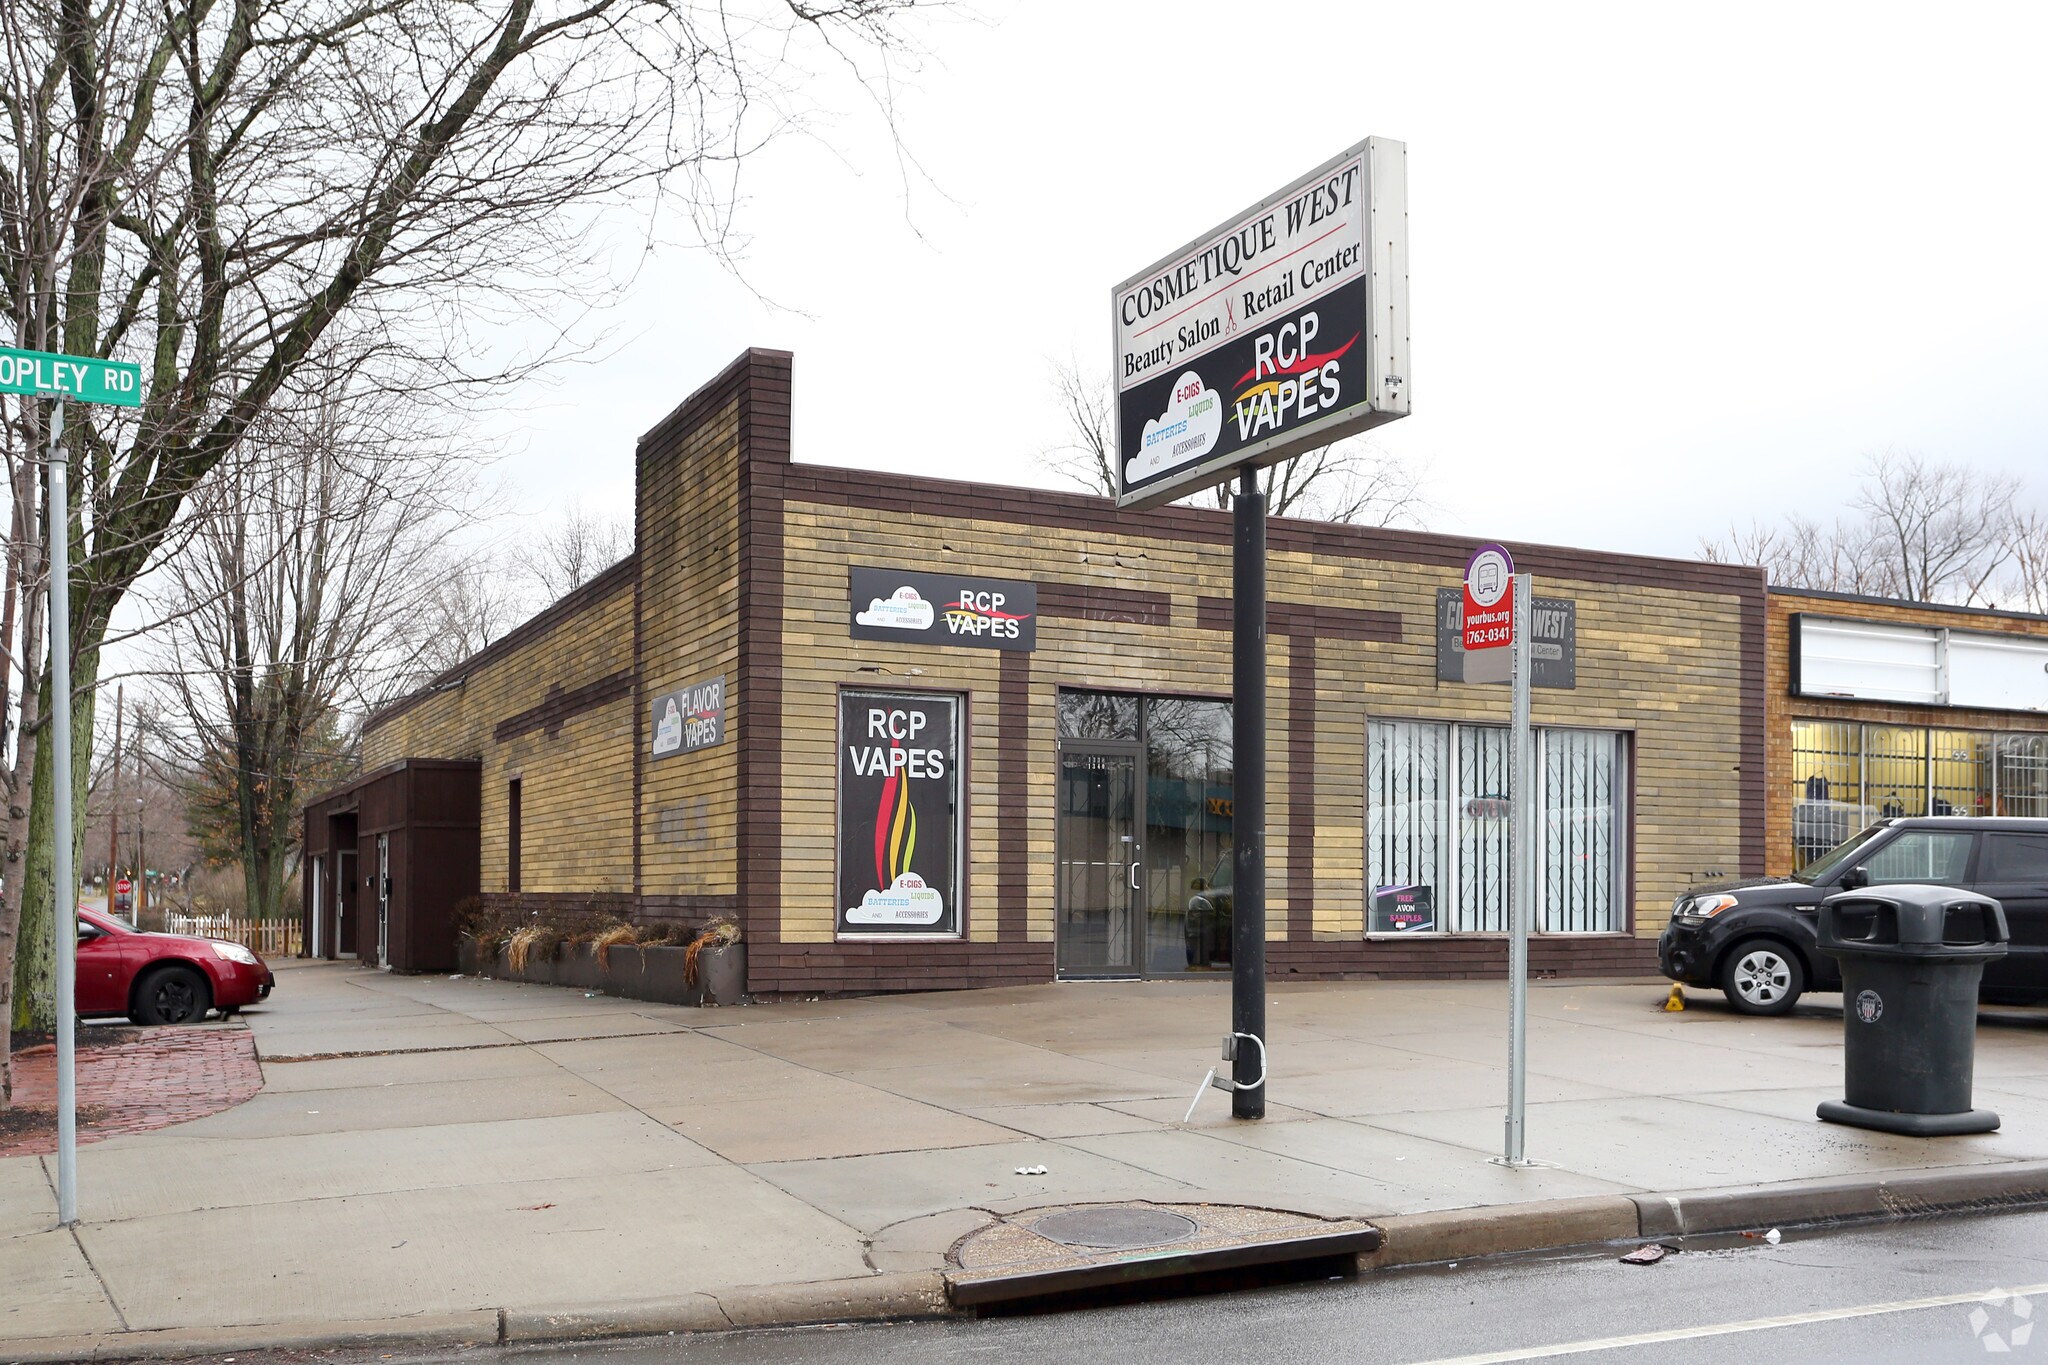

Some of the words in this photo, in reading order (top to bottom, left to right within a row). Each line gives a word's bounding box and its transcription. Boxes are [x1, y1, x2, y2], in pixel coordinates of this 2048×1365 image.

[1122, 214, 1278, 326] COSMETIQUE
[1285, 166, 1359, 238] WEST
[1124, 336, 1175, 378] Beauty
[1178, 316, 1220, 352] Salon
[1243, 271, 1294, 319] Retail
[1300, 242, 1360, 289] Center
[1254, 311, 1320, 381] RCP
[104, 368, 134, 392] RD
[1177, 381, 1200, 403] E-CIGS
[1235, 359, 1342, 442] VAPES
[1188, 397, 1213, 418] LIQUIDS
[1146, 420, 1188, 447] BATTERIES
[1149, 455, 1160, 467] AND
[1172, 432, 1207, 458] ACCESSORIES
[899, 591, 918, 600] E-CIGS
[959, 589, 1006, 613] RCP
[944, 613, 1020, 639] VAPES
[1466, 610, 1510, 629] yourbus.org
[1531, 608, 1568, 639] WEST
[1469, 626, 1510, 644] 762-0341
[1536, 644, 1560, 656] Center
[681, 683, 720, 718] FLAVOR
[685, 716, 716, 748] VAPES
[868, 708, 927, 740] RCP
[849, 745, 945, 780] VAPES
[117, 883, 132, 891] STOP
[900, 879, 922, 889] E-CIGS
[867, 898, 910, 906] BATTERIES
[910, 892, 935, 900] LIQUIDS
[1396, 894, 1414, 902] FREE
[895, 911, 929, 919] ACCESSORIES
[1389, 914, 1423, 922] SAMPLES
[1396, 904, 1416, 912] AVON
